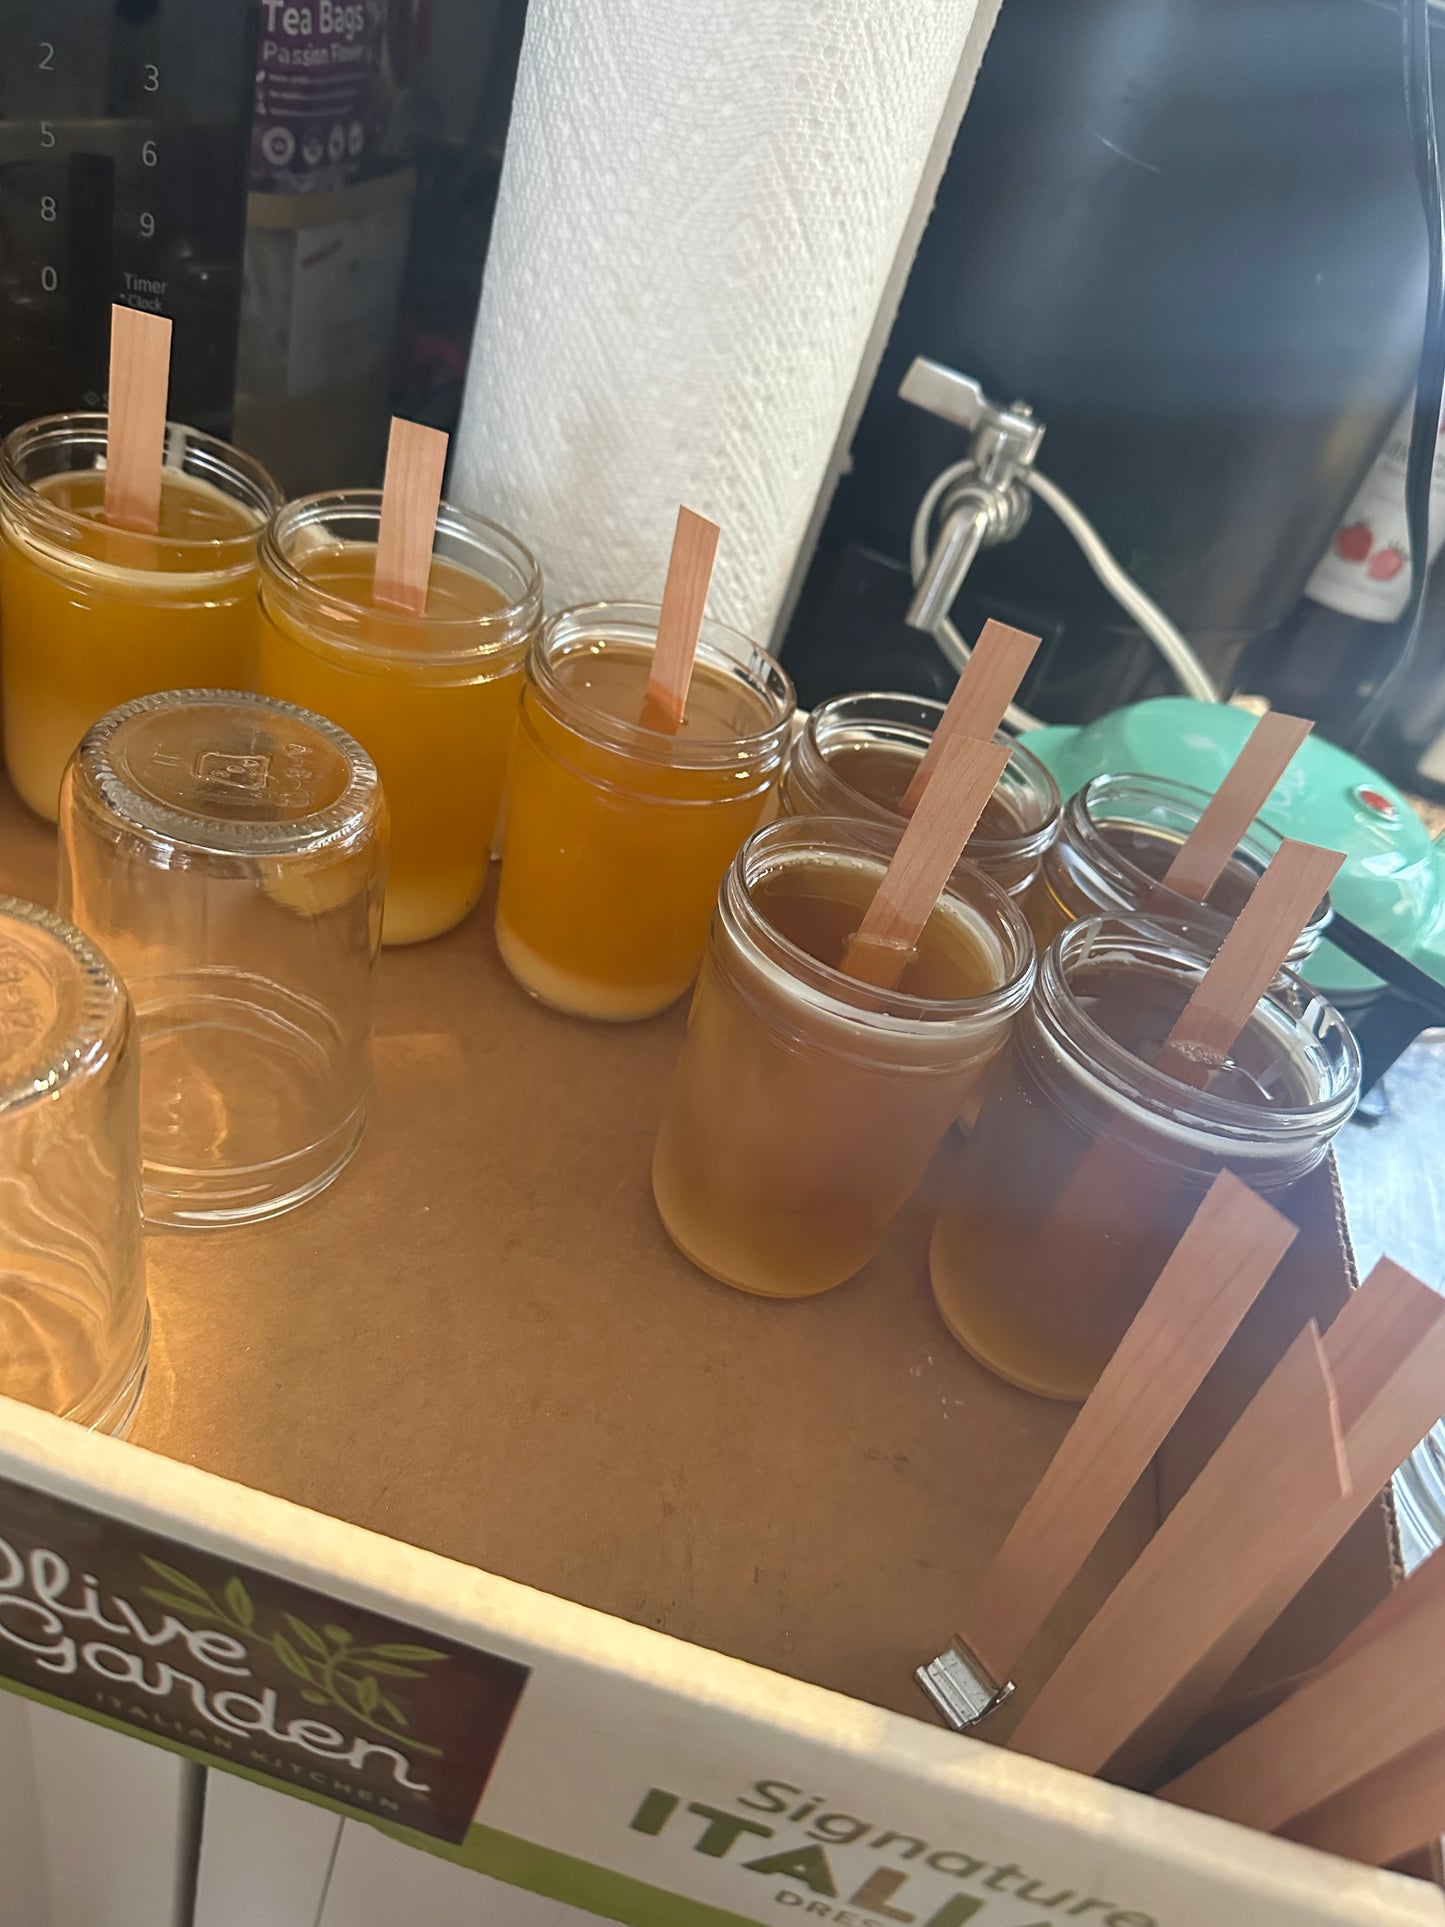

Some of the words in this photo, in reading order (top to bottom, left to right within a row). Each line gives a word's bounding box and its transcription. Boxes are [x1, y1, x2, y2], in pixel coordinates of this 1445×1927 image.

[262, 0, 313, 35] Tea
[319, 0, 364, 41] Bags
[38, 42, 54, 71] 2
[262, 41, 329, 66] Passion
[143, 64, 159, 92] 3
[40, 122, 56, 148] 5
[141, 140, 158, 167] 6
[40, 196, 56, 222] 8
[139, 213, 155, 238] 9
[124, 272, 168, 295] Timer
[127, 294, 162, 311] Clock
[0, 1595, 431, 1793] Garden
[96, 1691, 232, 1751] ITALIAN
[250, 1748, 399, 1811] KITCHEN
[628, 1787, 1053, 1927] ITALI
[737, 1779, 1159, 1927] Signature
